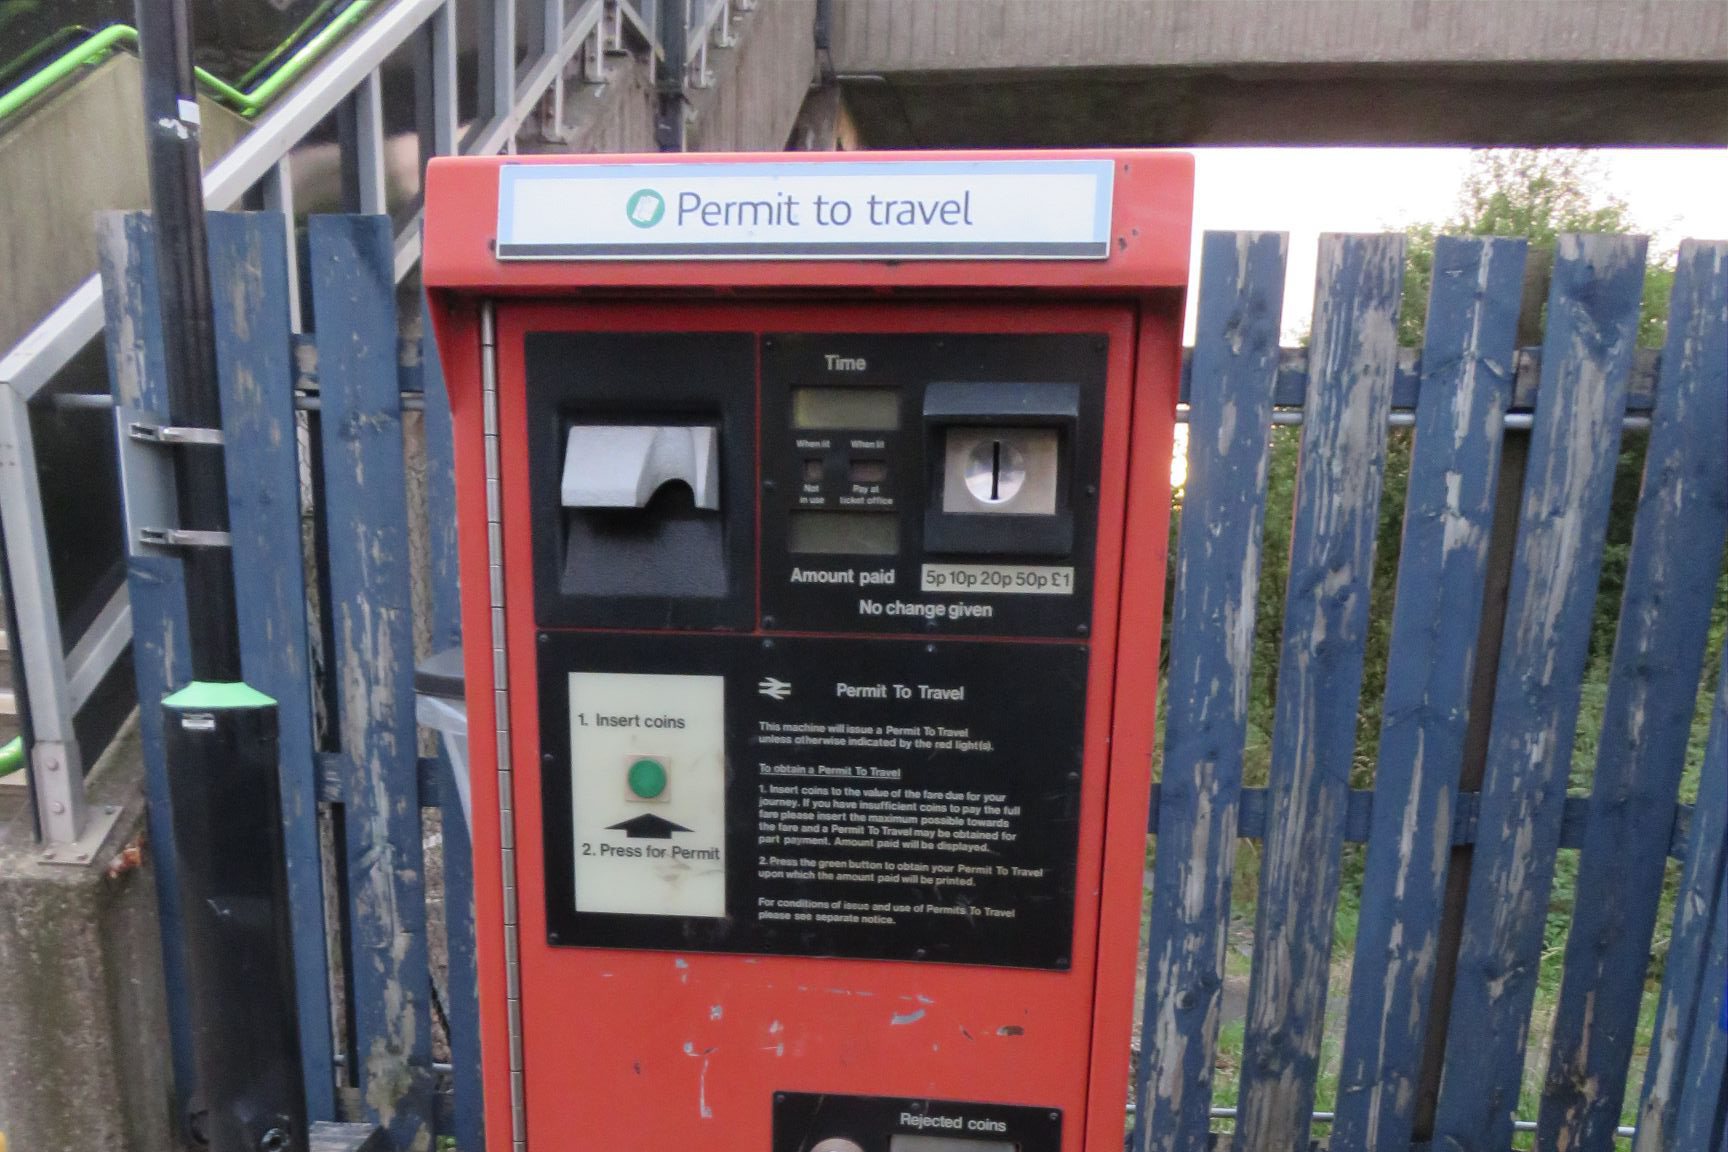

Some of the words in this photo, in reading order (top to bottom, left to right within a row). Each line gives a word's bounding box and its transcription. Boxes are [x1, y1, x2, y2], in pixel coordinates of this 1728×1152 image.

[677, 190, 800, 227] Permit
[813, 194, 852, 227] to
[867, 190, 973, 226] travel
[824, 354, 867, 371] Time
[839, 497, 865, 505] ticket
[866, 496, 894, 505] office
[790, 567, 855, 584] Amount
[859, 569, 896, 587] paid
[926, 571, 947, 587] 5p
[949, 571, 977, 588] 10p
[980, 571, 1013, 589] 20p
[1015, 572, 1048, 590] 50p
[1051, 573, 1070, 588] £1
[859, 600, 883, 615] No
[885, 602, 946, 619] change
[948, 602, 993, 620] given
[836, 682, 888, 698] Permit
[892, 685, 913, 699] To
[918, 685, 965, 701] Travel
[578, 712, 588, 727] 1.
[596, 712, 640, 728] Insert
[644, 715, 686, 729] coins
[759, 721, 781, 732] This
[782, 723, 826, 733] machine
[827, 724, 845, 734] will
[846, 724, 874, 735] issue
[875, 726, 883, 735] a
[885, 725, 921, 737] Permit
[924, 726, 936, 737] To
[937, 727, 969, 738] Travel
[759, 735, 792, 744] unless
[794, 737, 847, 746] otherwise
[848, 737, 897, 747] indicated
[899, 738, 913, 750] by
[914, 739, 933, 750] the
[935, 740, 953, 750] red
[759, 762, 772, 774] To
[773, 764, 806, 775] obtain
[807, 767, 815, 776] a
[817, 765, 852, 776] Permit
[855, 766, 868, 777] To
[870, 766, 901, 779] Travel
[758, 784, 767, 794] 1.
[769, 784, 799, 795] Insert
[801, 785, 829, 796] coins
[830, 786, 842, 796] to
[843, 786, 862, 797] the
[862, 787, 890, 798] value
[890, 788, 902, 799] of
[904, 788, 922, 799] the
[923, 788, 944, 800] fare
[944, 790, 965, 801] due
[966, 791, 981, 801] for
[982, 793, 1007, 803] your
[758, 796, 801, 809] journey.
[802, 797, 811, 808] If
[811, 800, 832, 810] you
[832, 799, 857, 810] have
[859, 800, 918, 812] insufficient
[919, 803, 948, 813] coins
[949, 803, 961, 814] to
[962, 805, 982, 816] pay
[983, 804, 1002, 815] the
[1002, 804, 1021, 816] full
[759, 809, 779, 820] fare
[780, 809, 816, 822] please
[816, 812, 847, 822] insert
[849, 812, 868, 823] the
[867, 813, 919, 825] maximum
[920, 815, 966, 826] possible
[966, 818, 1010, 828] towards
[759, 821, 777, 832] the
[778, 822, 800, 833] fare
[800, 823, 821, 833] and
[821, 825, 829, 834] a
[830, 823, 866, 835] Permit
[867, 825, 881, 836] To
[881, 825, 914, 837] Travel
[913, 827, 937, 840] may
[937, 828, 952, 838] be
[952, 829, 1000, 841] obtained
[1001, 831, 1018, 842] for
[582, 843, 597, 857] 2.
[600, 844, 642, 858] Press
[646, 845, 668, 858] for
[671, 846, 721, 861] Permit
[759, 834, 781, 846] part
[783, 836, 832, 847] payment.
[833, 836, 875, 848] Amount
[876, 839, 901, 850] paid
[901, 840, 920, 850] will
[920, 840, 936, 851] be
[936, 840, 991, 853] displayed.
[759, 856, 769, 866] 2.
[769, 856, 799, 868] Press
[799, 858, 817, 868] the
[817, 860, 848, 870] green
[848, 859, 883, 870] button
[884, 861, 896, 871] to
[896, 862, 930, 872] obtain
[930, 864, 956, 874] your
[957, 863, 993, 875] Permit
[995, 866, 1009, 877] To
[1011, 866, 1044, 878] Travel
[758, 869, 785, 880] upon
[785, 870, 816, 880] which
[817, 871, 835, 881] the
[836, 872, 875, 882] amount
[876, 873, 901, 884] paid
[901, 874, 919, 884] will
[920, 874, 934, 885] be
[934, 876, 977, 887] printed.
[758, 897, 776, 907] For
[776, 898, 831, 910] conditions
[830, 900, 842, 910] of
[842, 901, 871, 911] issue
[871, 902, 892, 913] and
[892, 904, 912, 913] use
[913, 904, 925, 914] of
[926, 904, 967, 916] Permits
[969, 906, 983, 917] To
[983, 906, 1016, 919] Travel
[758, 911, 792, 921] please
[794, 912, 814, 922] see
[815, 913, 861, 924] separate
[861, 914, 897, 925] notice.
[899, 1112, 964, 1129] Rejected
[967, 1118, 1008, 1132] coins
